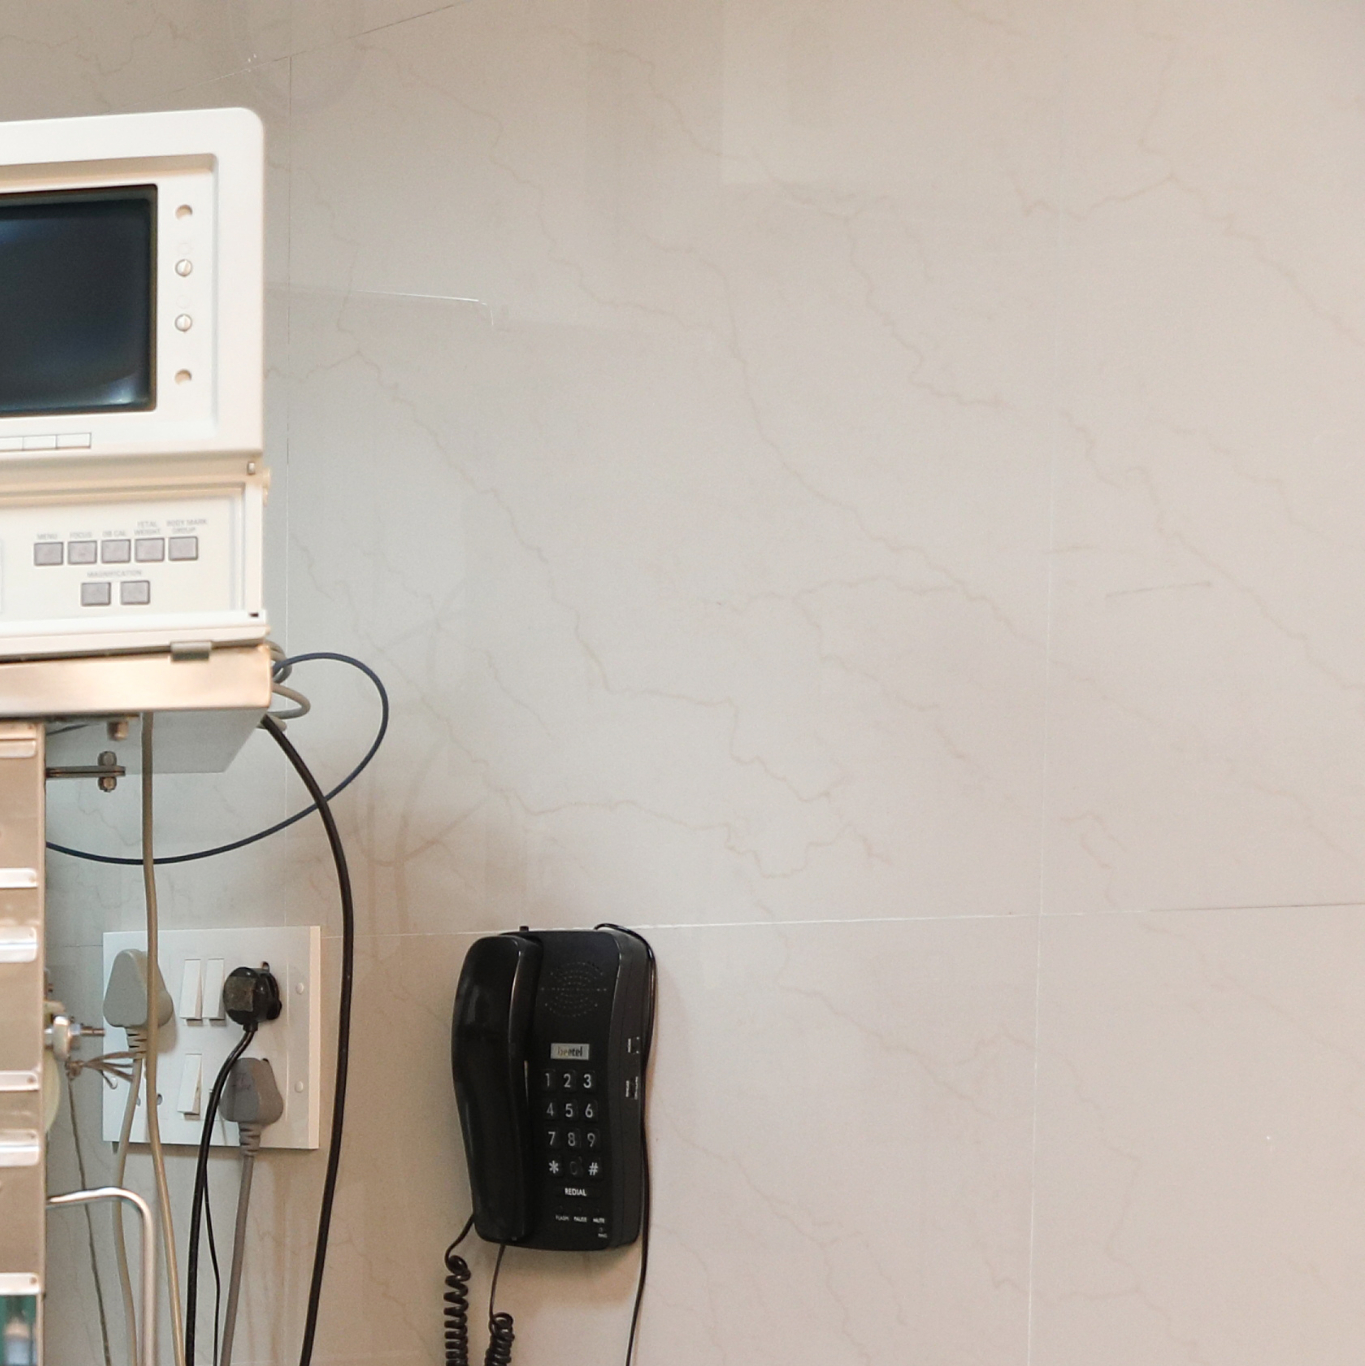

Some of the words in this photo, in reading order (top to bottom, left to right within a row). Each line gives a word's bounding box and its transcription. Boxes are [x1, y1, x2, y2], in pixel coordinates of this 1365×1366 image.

[545, 1073, 550, 1087] 1
[563, 1073, 571, 1088] 2
[583, 1074, 592, 1089] 3
[546, 1103, 554, 1117] 4
[565, 1104, 574, 1118] 5
[585, 1104, 594, 1118] 6
[548, 1131, 556, 1146] 7
[567, 1132, 576, 1147] 8
[587, 1133, 596, 1148] 9
[564, 1187, 587, 1197] REDIAL
